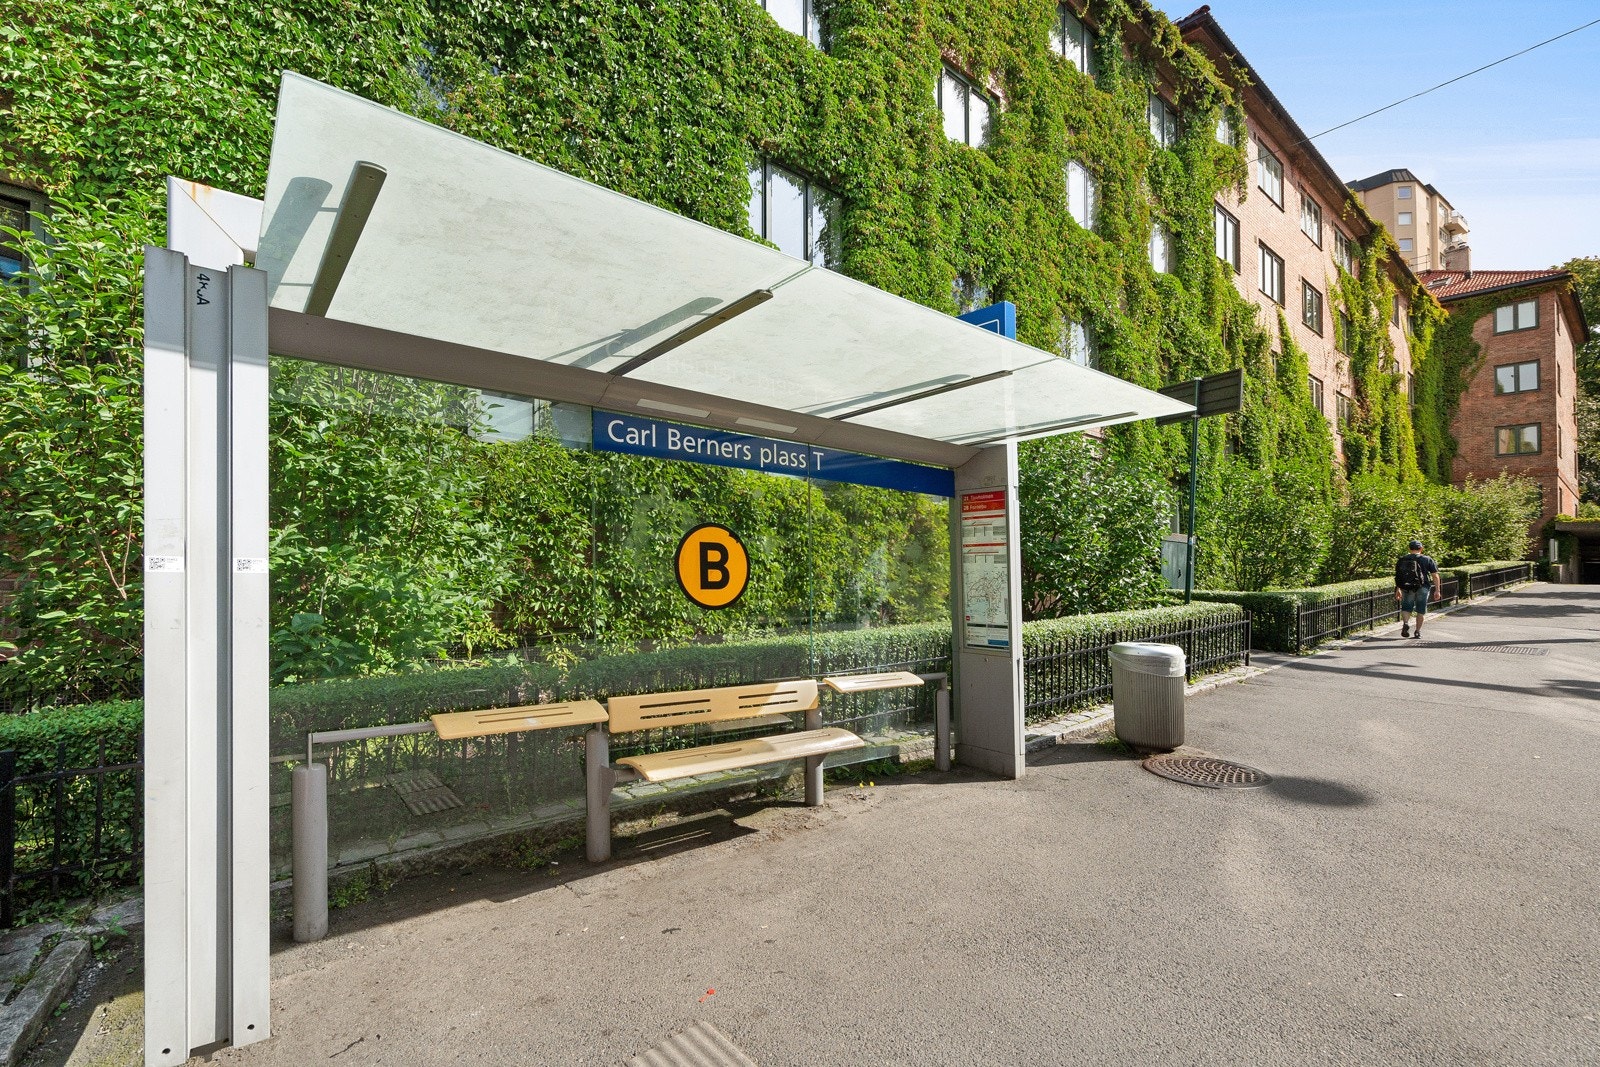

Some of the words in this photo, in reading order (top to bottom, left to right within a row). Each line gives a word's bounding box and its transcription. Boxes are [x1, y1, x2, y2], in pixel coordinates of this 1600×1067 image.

[607, 419, 656, 447] Carl
[668, 428, 751, 460] Berners
[760, 444, 808, 468] plass
[813, 452, 824, 470] T
[699, 541, 730, 590] B
